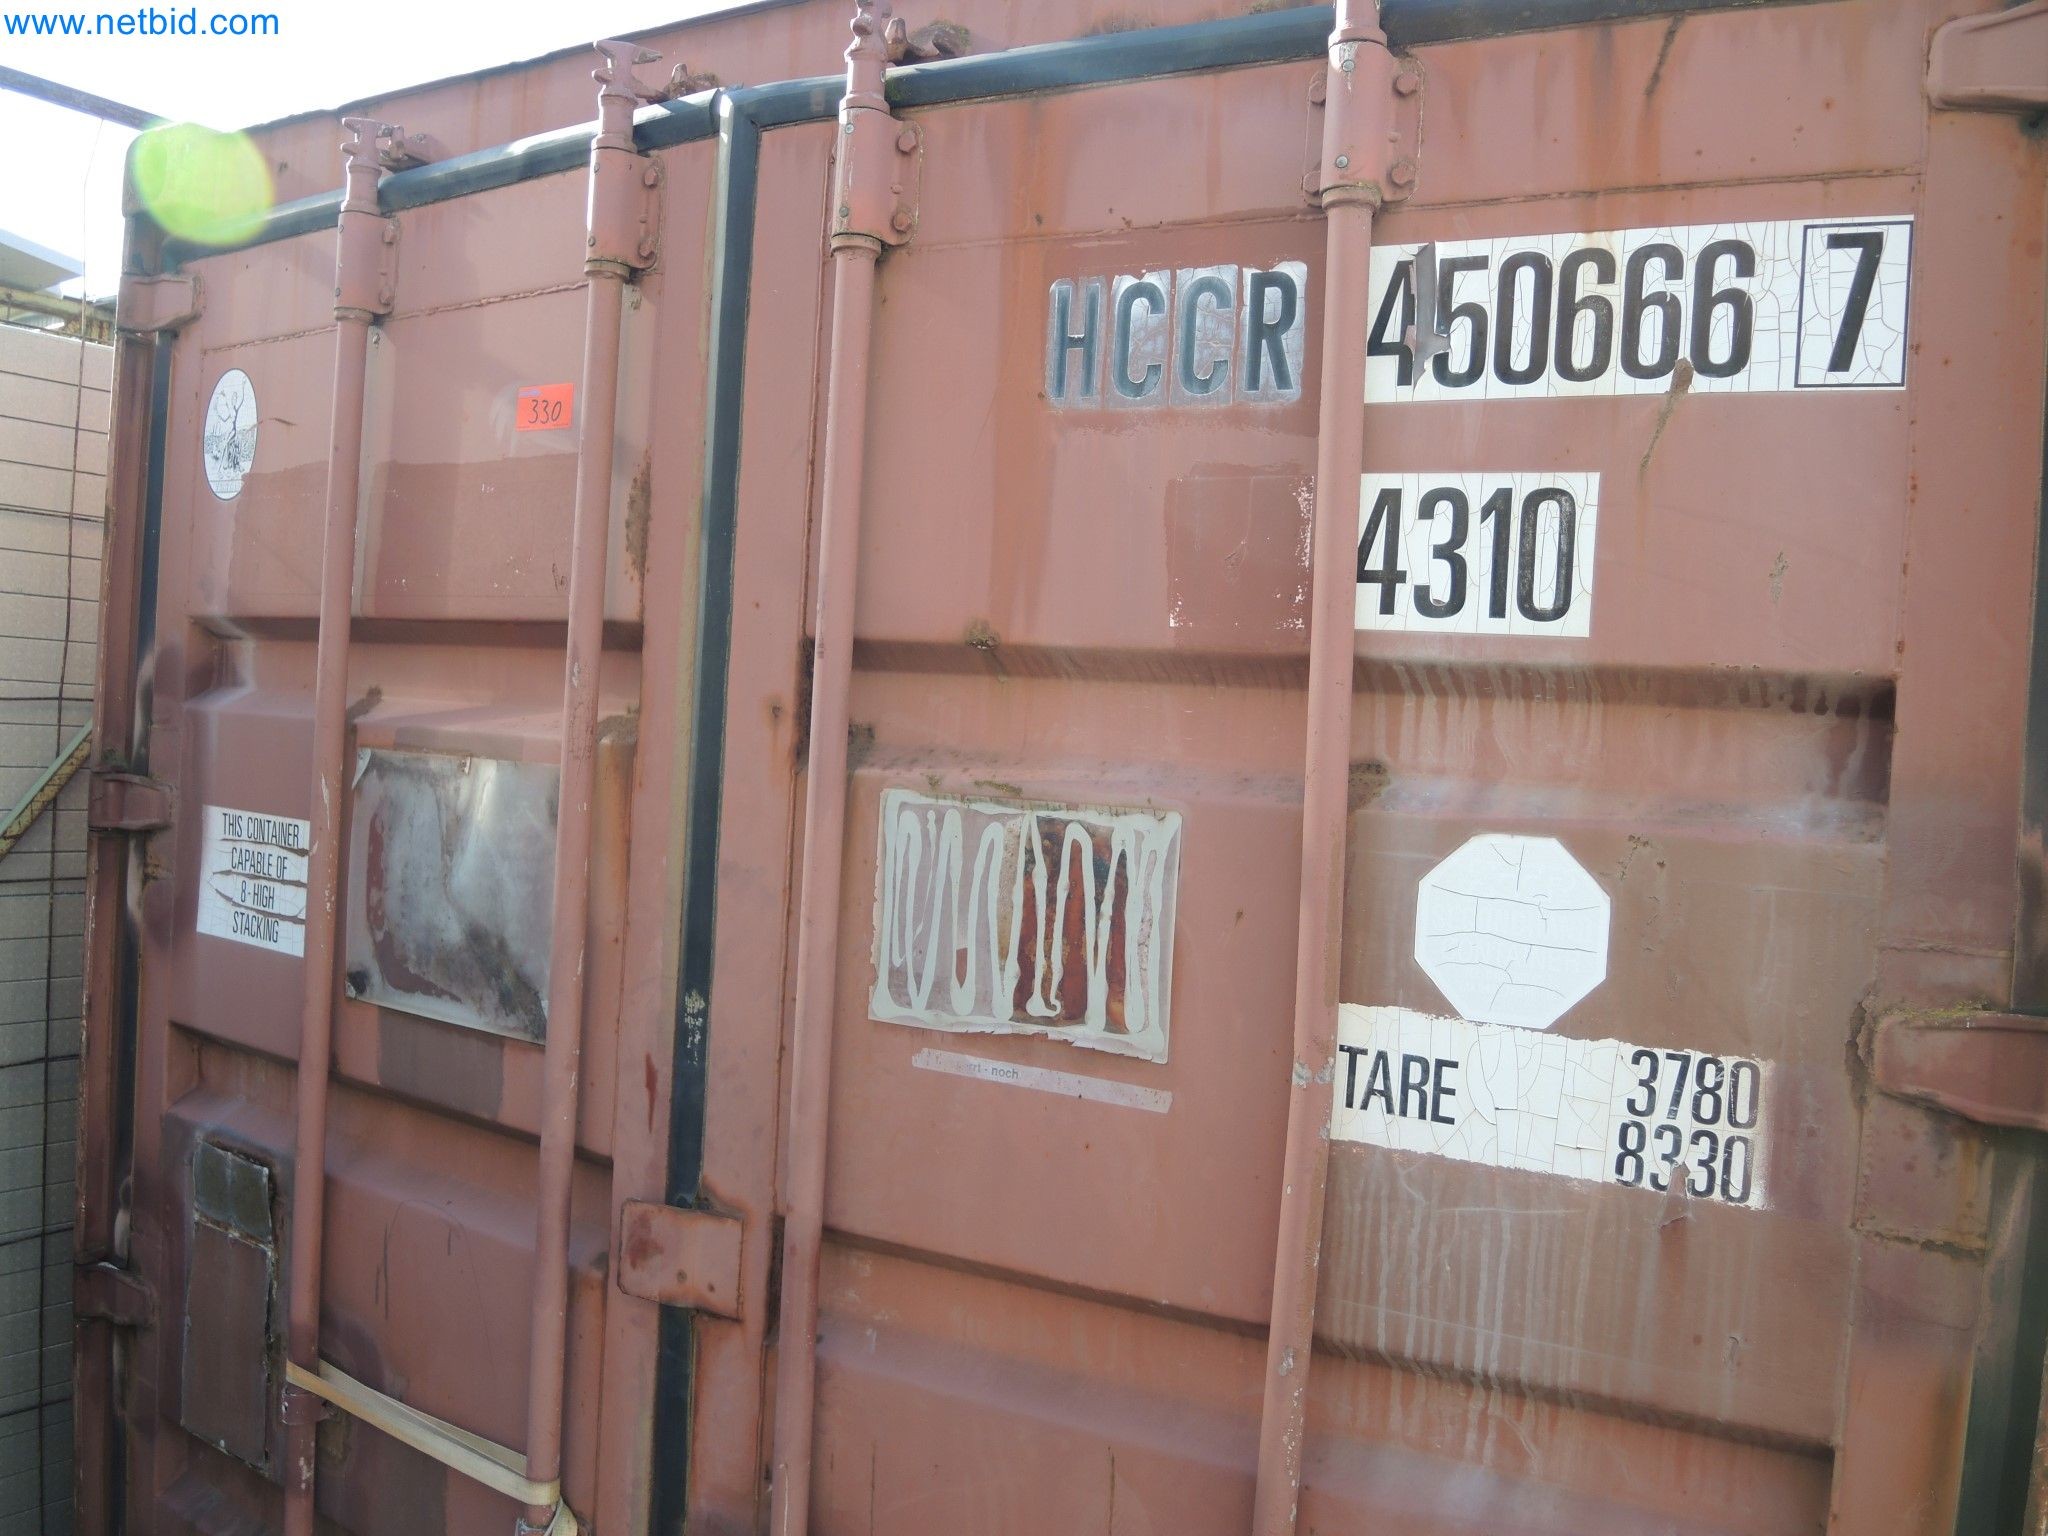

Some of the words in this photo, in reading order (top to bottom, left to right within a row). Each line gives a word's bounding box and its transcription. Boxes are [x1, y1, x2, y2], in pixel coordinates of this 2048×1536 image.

[1052, 270, 1298, 398] HCCR
[1366, 240, 1756, 388] 450666
[1826, 231, 1886, 373] 7
[527, 399, 562, 424] 330
[1357, 487, 1578, 622] 4310
[222, 812, 243, 838] THIS
[247, 816, 299, 848] CONTAINER
[231, 847, 273, 876] CAPABLE
[276, 855, 288, 880] OF
[232, 911, 279, 943] STACKING
[991, 1066, 1019, 1080] noch
[1338, 1043, 1460, 1126] TARE
[1626, 1049, 1760, 1129] 3780
[1615, 1120, 1753, 1203] 8330
